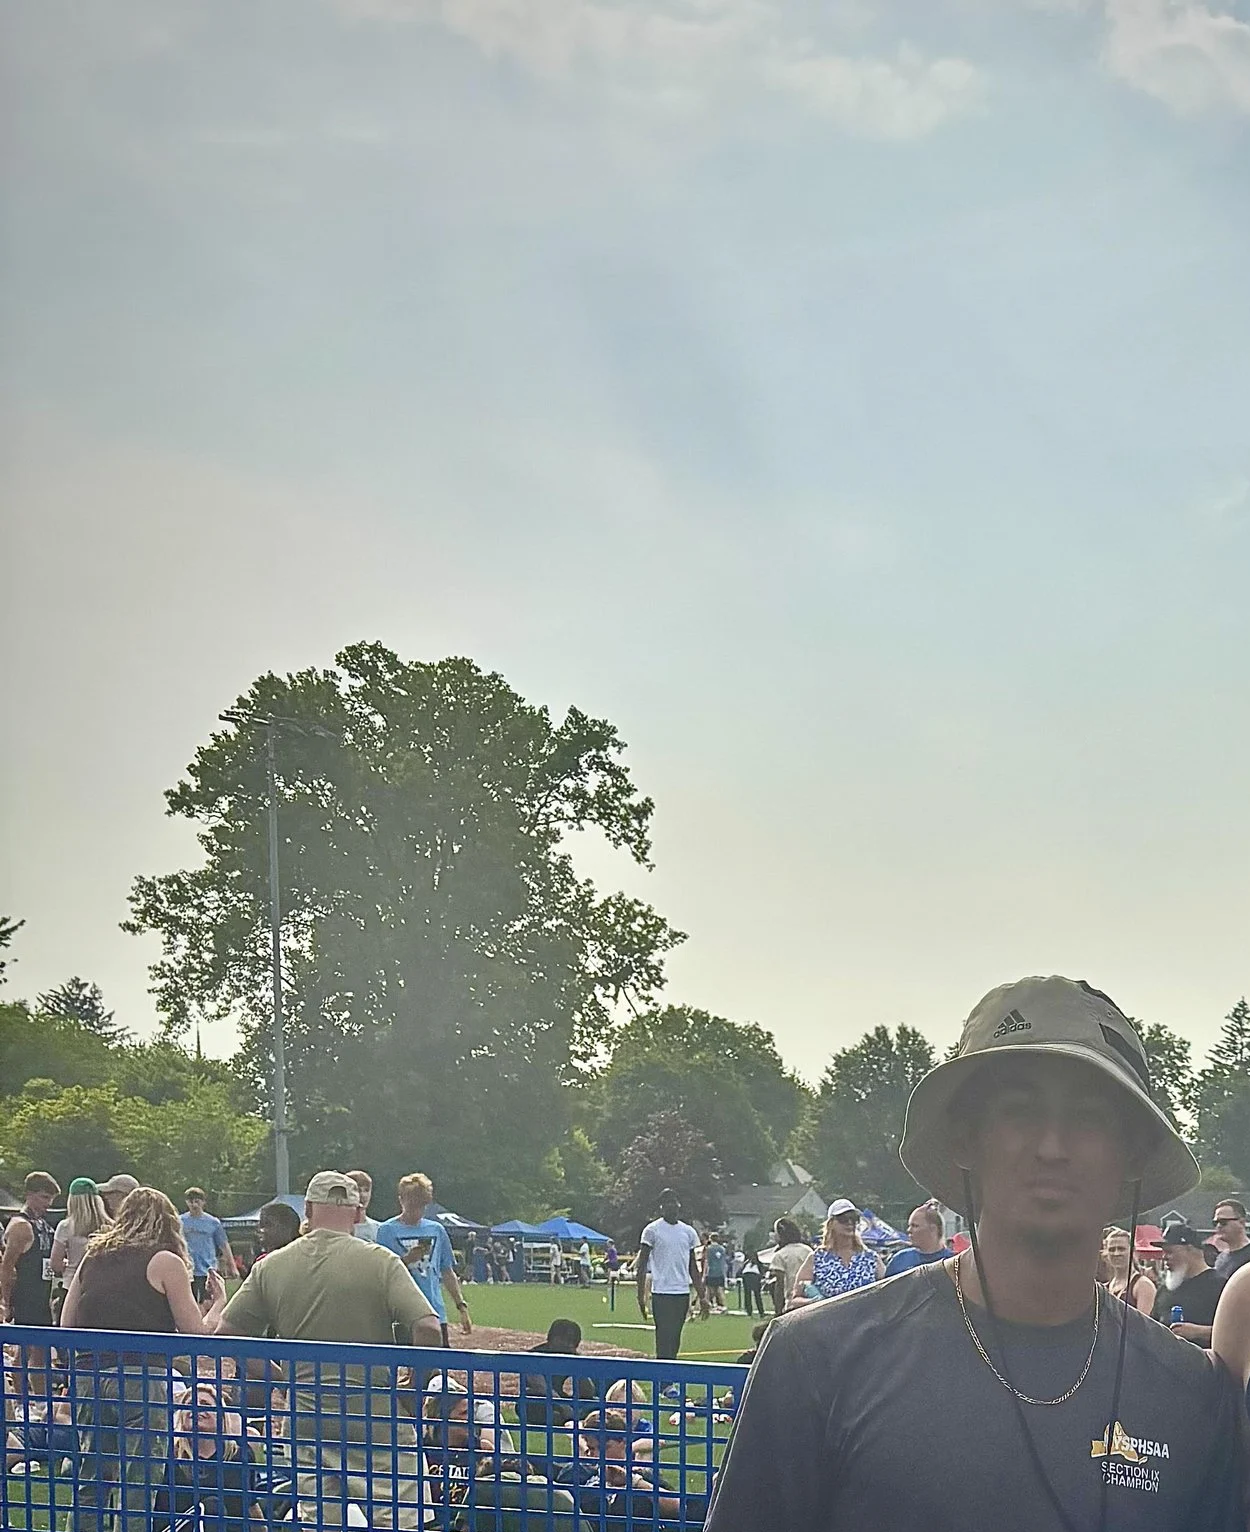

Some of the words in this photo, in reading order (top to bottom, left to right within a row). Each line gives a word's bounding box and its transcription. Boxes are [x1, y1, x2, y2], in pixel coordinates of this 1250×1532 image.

[993, 1022, 1032, 1039] adidas
[1101, 1461, 1149, 1480] SECTION
[1151, 1469, 1160, 1482] IX
[1102, 1472, 1159, 1493] CHAMPION
